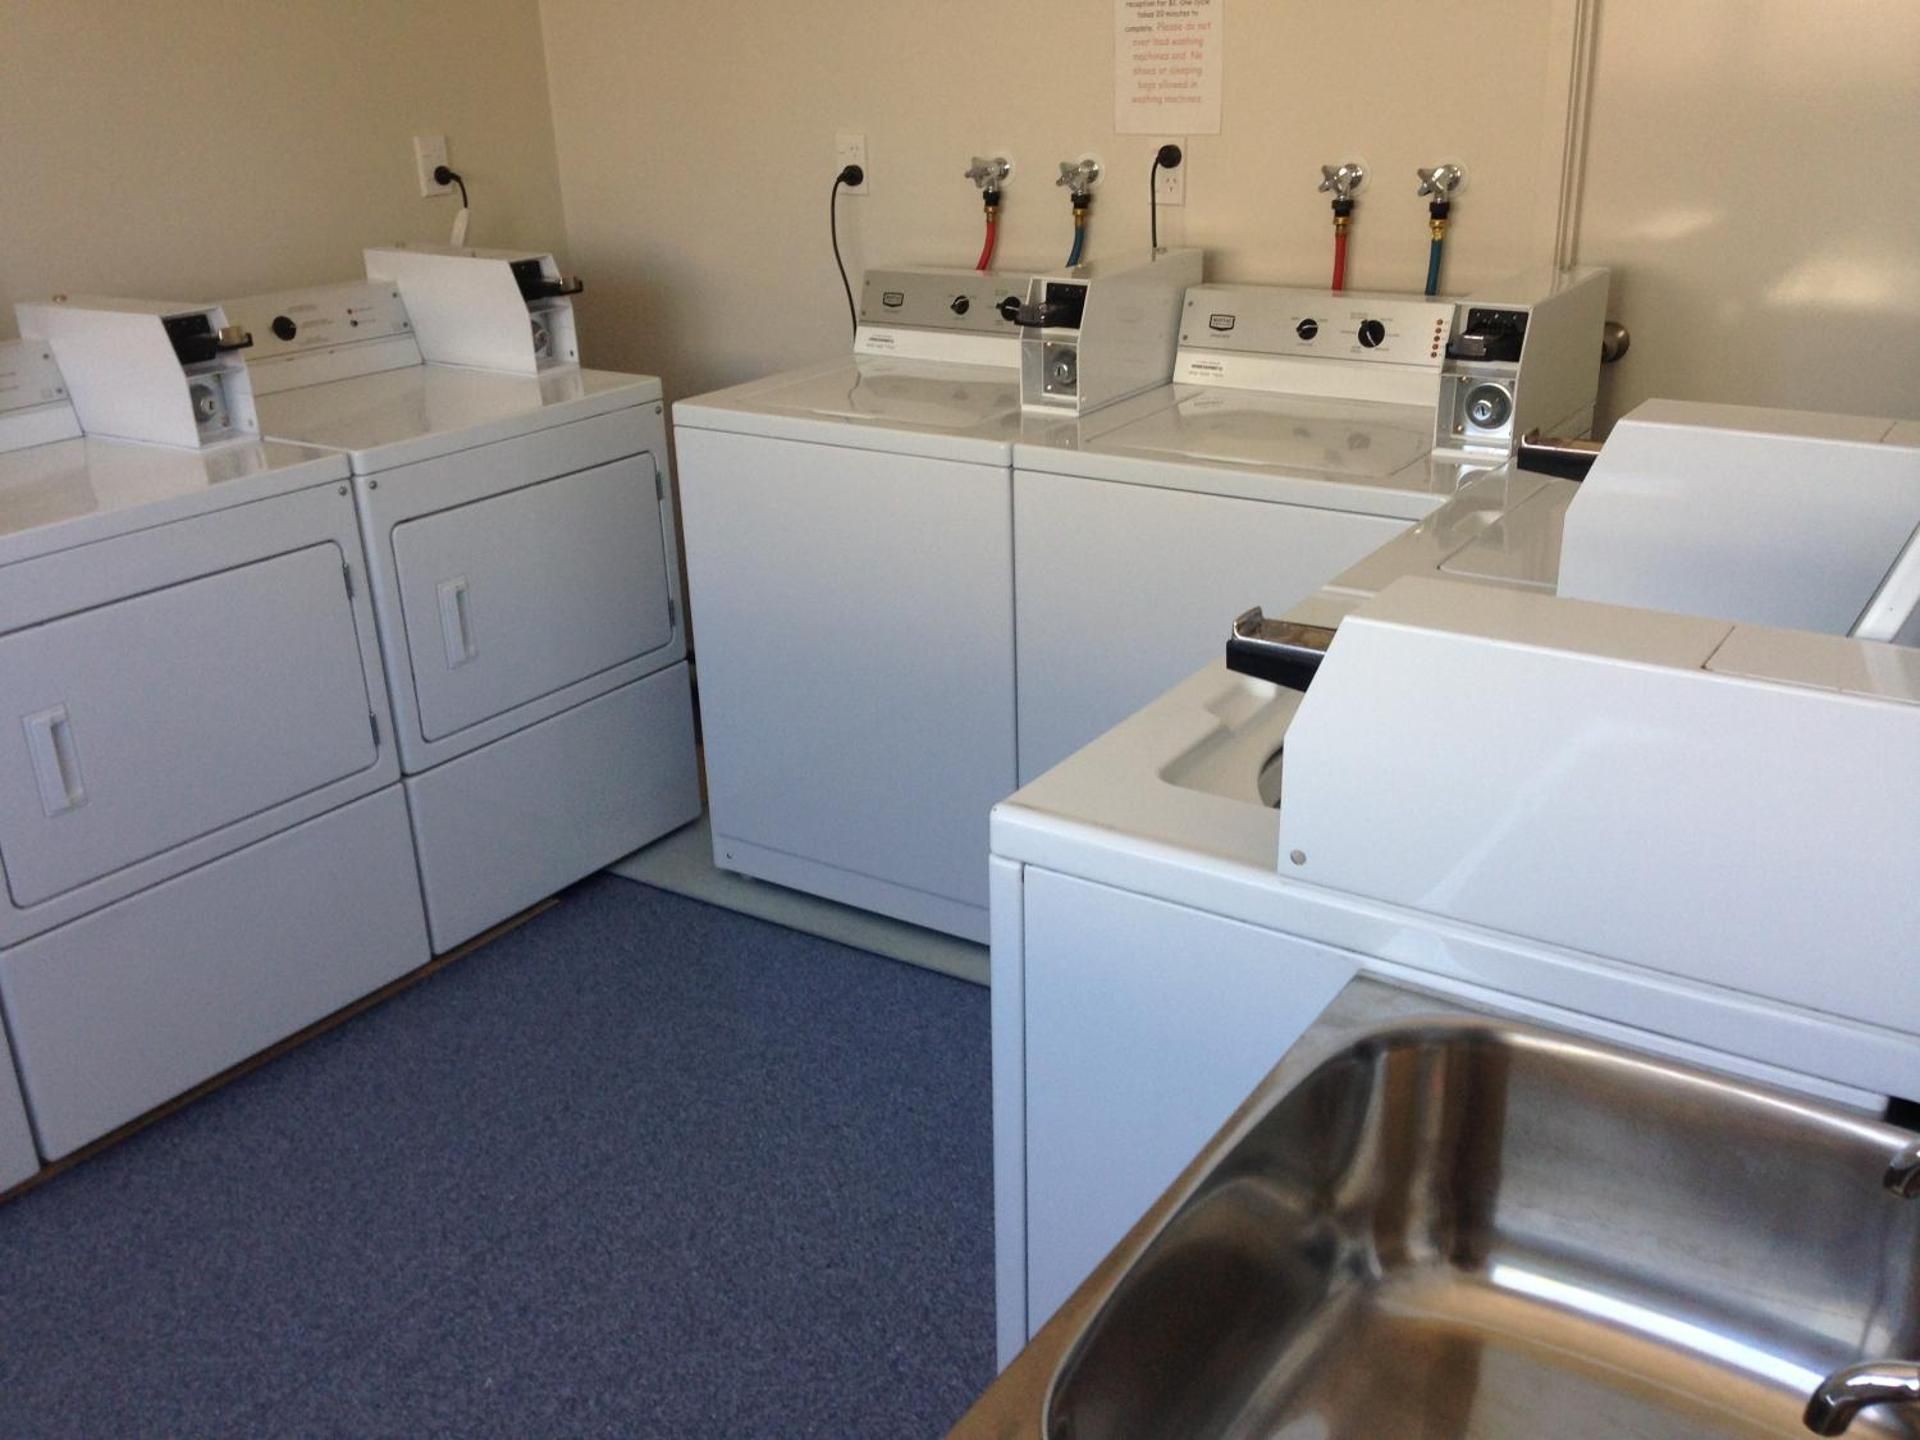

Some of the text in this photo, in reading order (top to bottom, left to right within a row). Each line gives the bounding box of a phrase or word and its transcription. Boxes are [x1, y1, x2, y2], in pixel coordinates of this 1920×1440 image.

[1157, 21, 1183, 31] Please
[1185, 22, 1196, 30] do
[1198, 21, 1211, 30] not
[1171, 37, 1204, 48] washing
[1133, 51, 1169, 61] machines
[1132, 94, 1163, 105] washing
